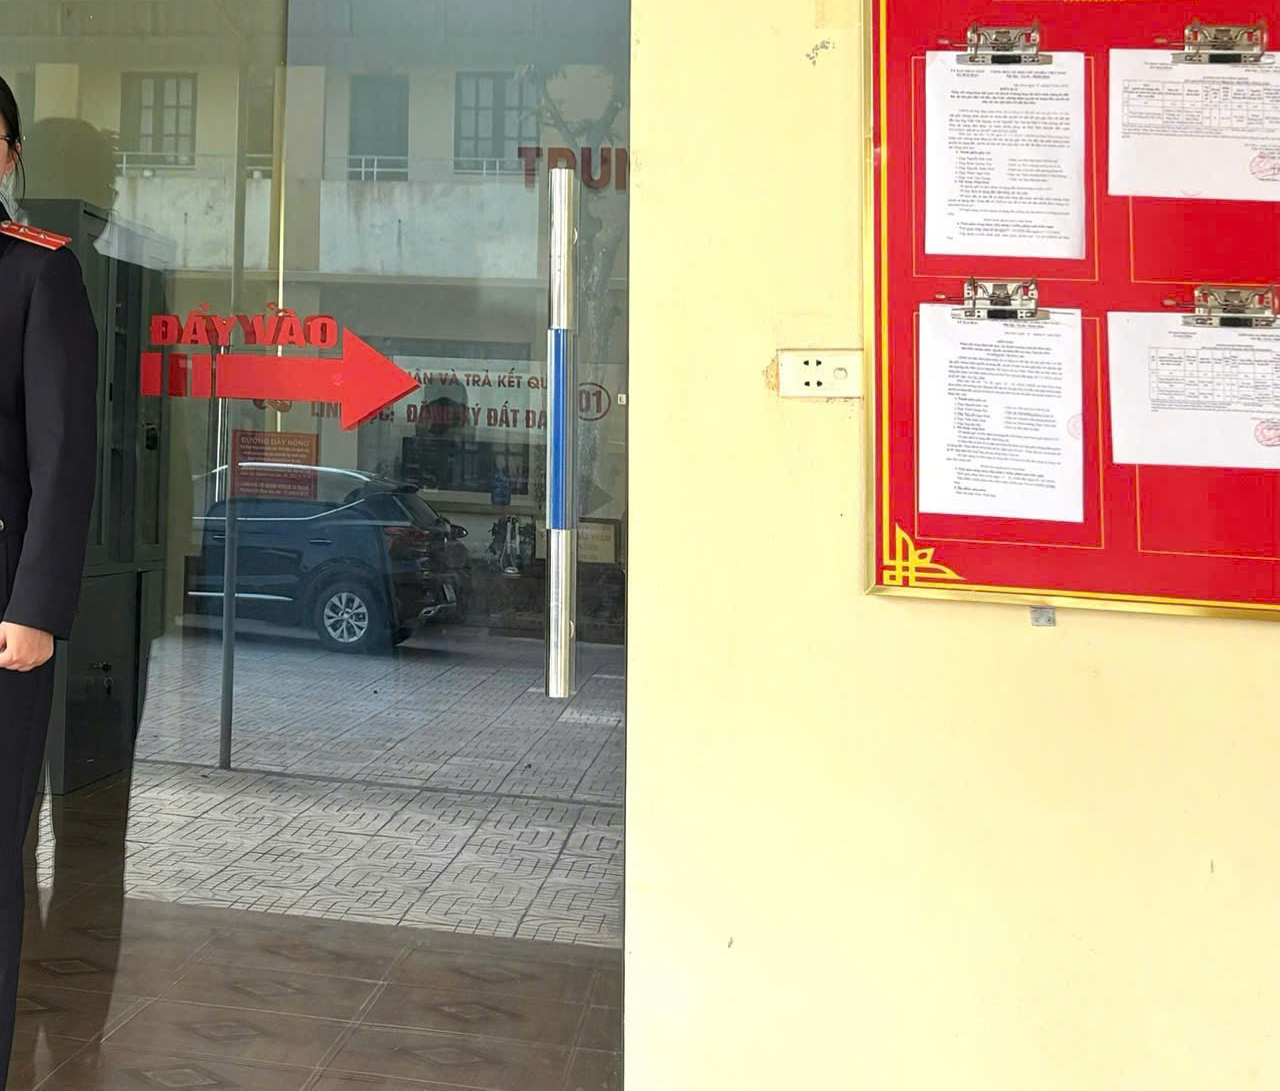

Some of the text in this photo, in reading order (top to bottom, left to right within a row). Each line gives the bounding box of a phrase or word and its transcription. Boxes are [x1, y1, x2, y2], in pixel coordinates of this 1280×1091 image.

[151, 302, 338, 349] ĐẨY VÀO
[438, 368, 458, 386] VÀ
[463, 369, 491, 388] TRẢ
[498, 367, 522, 389] KẾT
[528, 374, 548, 389] QU
[578, 389, 602, 414] 01
[486, 401, 519, 429] ĐẤT
[525, 409, 548, 430] ĐA
